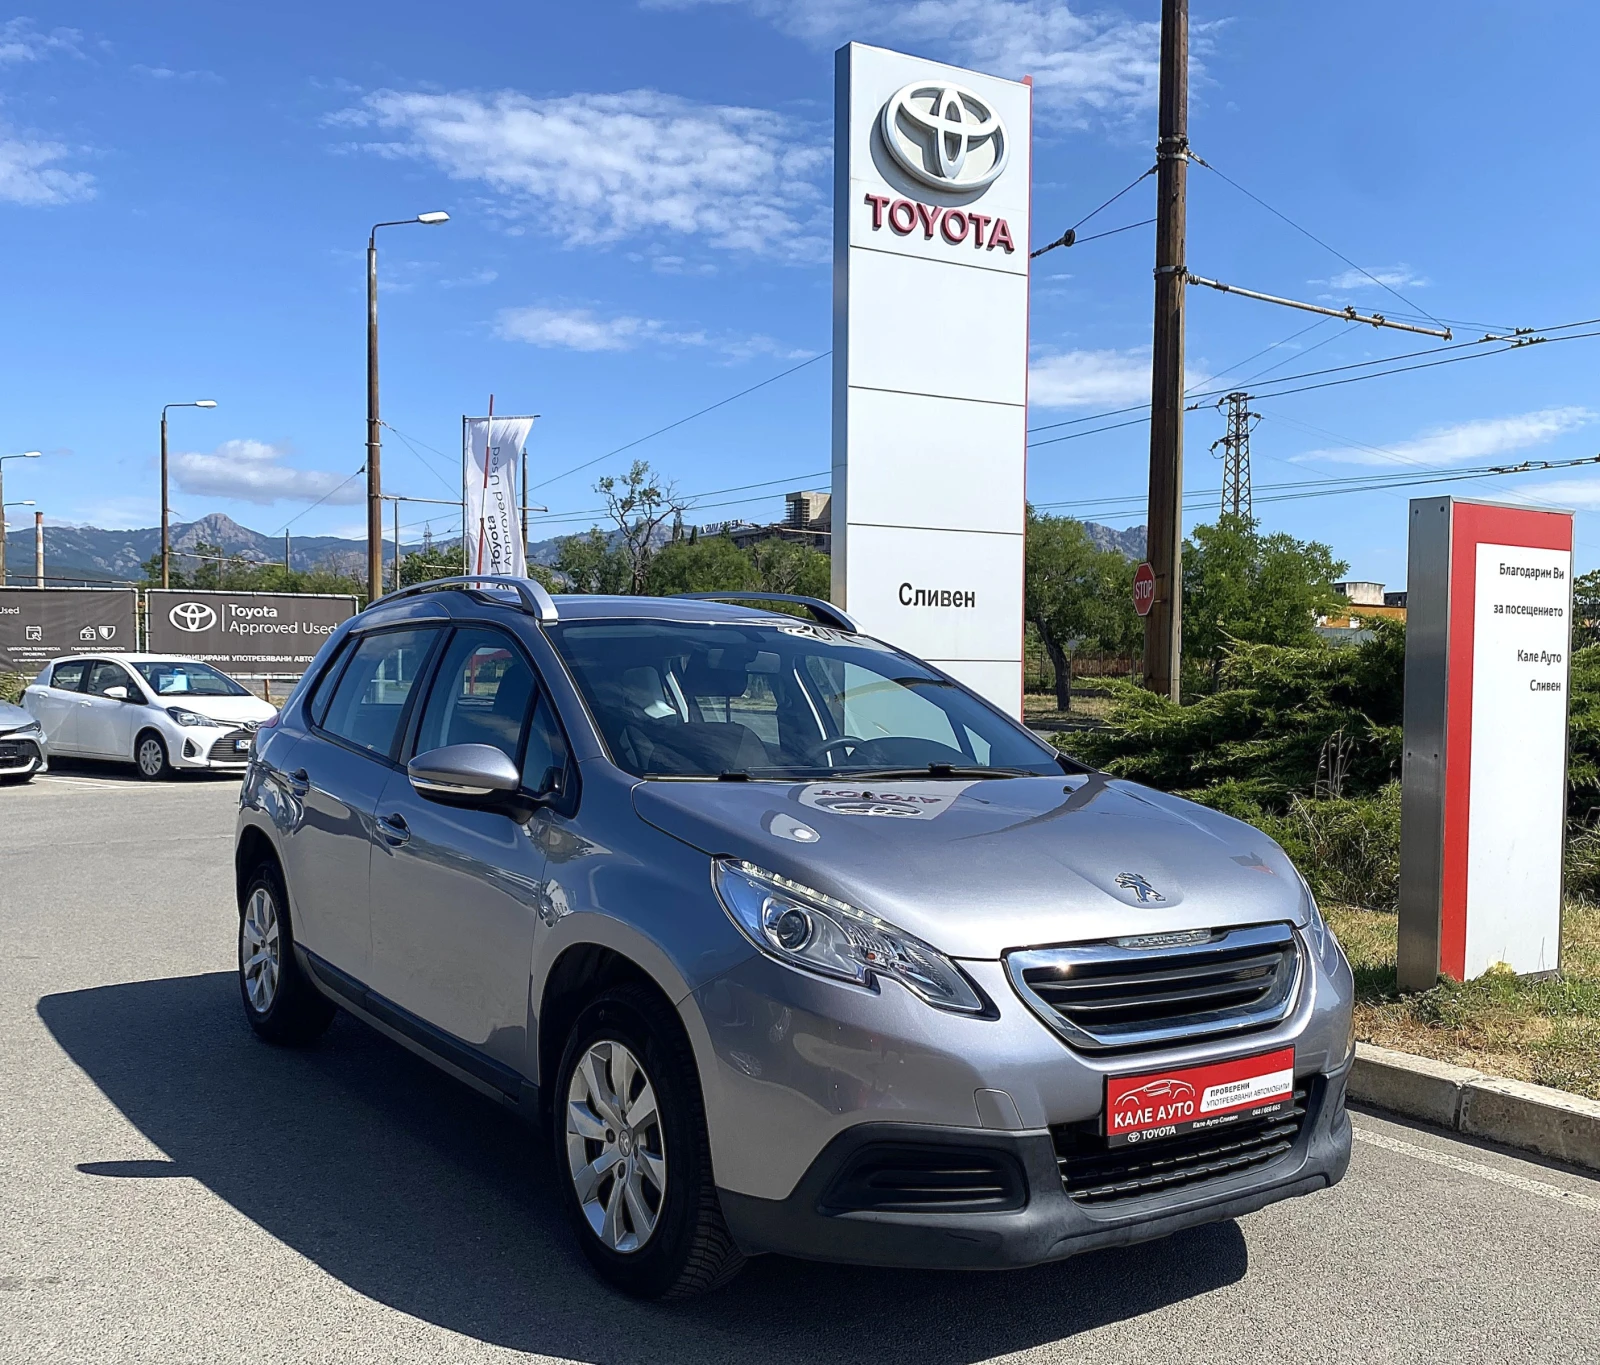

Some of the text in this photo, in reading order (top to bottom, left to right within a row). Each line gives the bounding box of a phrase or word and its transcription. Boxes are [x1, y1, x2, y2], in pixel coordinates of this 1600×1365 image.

[865, 193, 1014, 253] TOYOTA
[491, 446, 512, 566] Approved Used
[488, 516, 501, 568] Toyota
[1499, 563, 1565, 581] Благодарим Ви
[898, 582, 976, 608] Сливен
[1135, 579, 1153, 600] STOP
[229, 604, 278, 620] Toyota
[1493, 604, 1564, 617] за посещението
[229, 620, 298, 635] Approved
[231, 654, 293, 663] УПОТРЕБЯВАНИ
[1517, 649, 1562, 665] Кале Ауто
[1529, 679, 1562, 692] Сливен
[1206, 1082, 1290, 1108] УПОТРЕБЯВАНИ АВТОМОБИЛИ
[1210, 1082, 1250, 1097] ПРОВЕРЕНИ
[1114, 1100, 1194, 1128] КАЛЕ АУТО
[1141, 1125, 1177, 1140] TOYOTA
